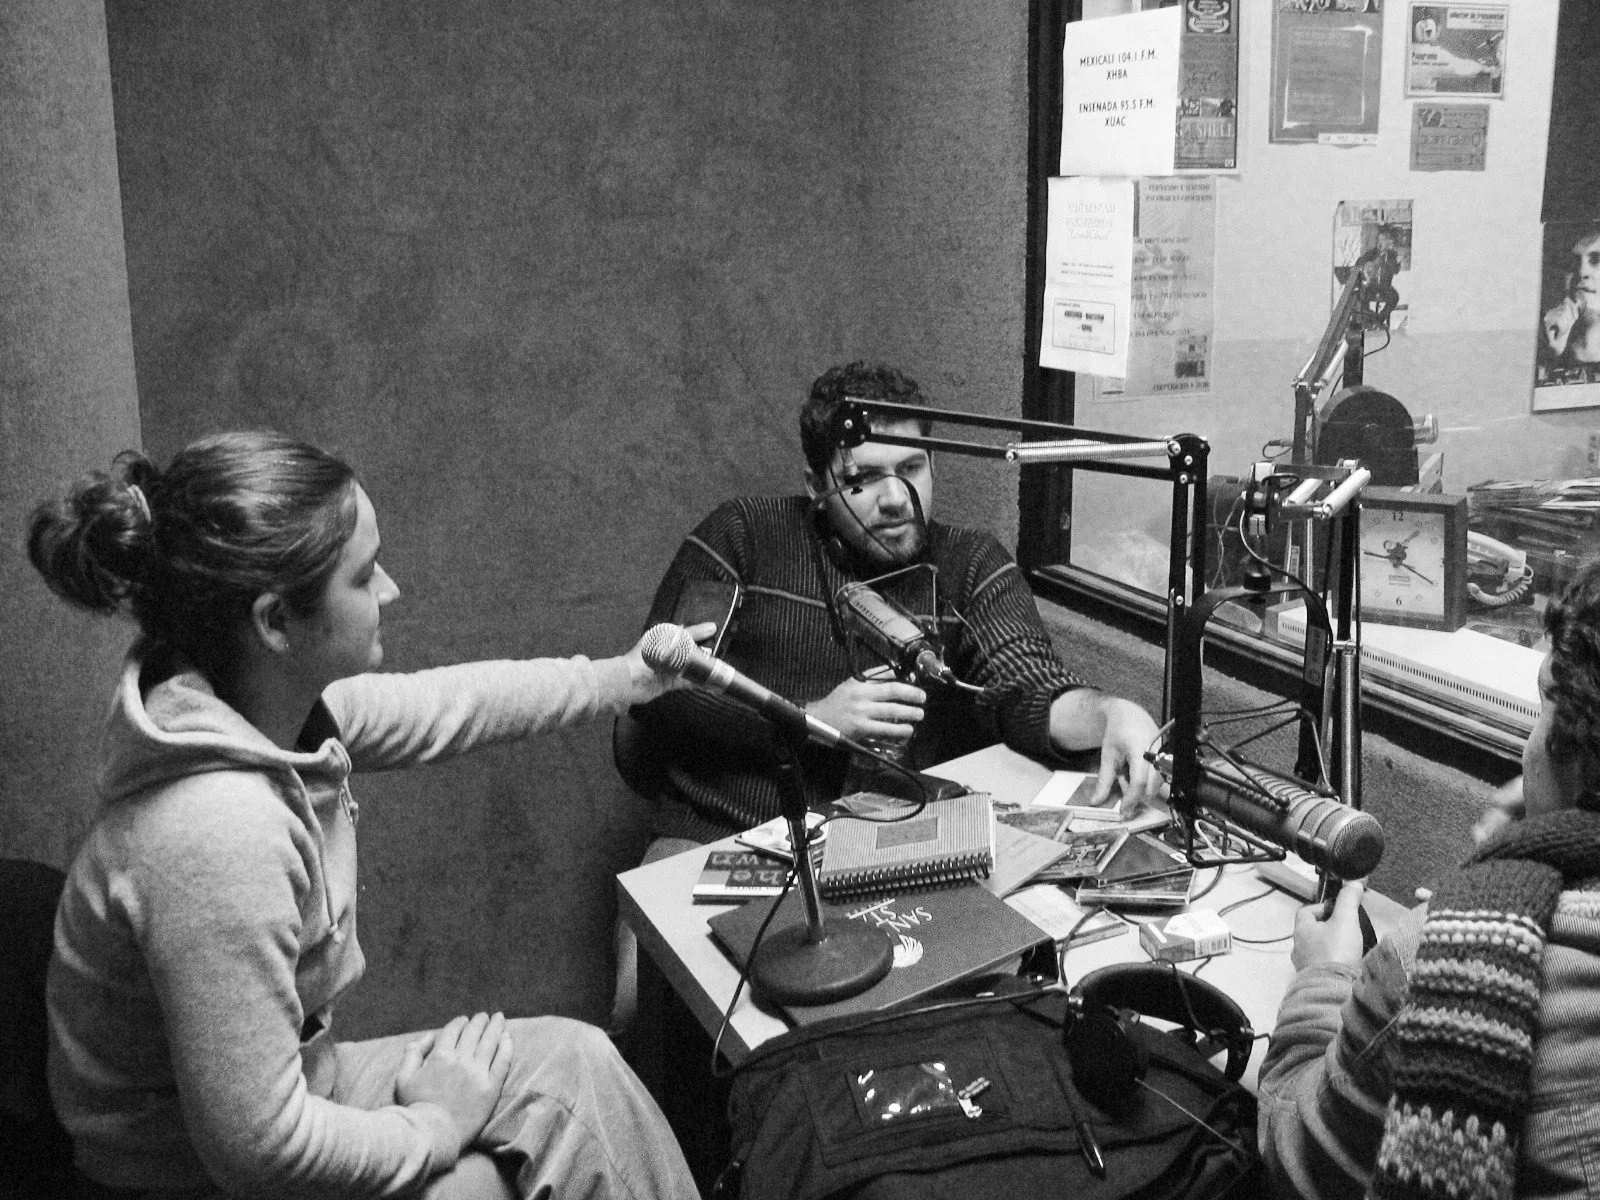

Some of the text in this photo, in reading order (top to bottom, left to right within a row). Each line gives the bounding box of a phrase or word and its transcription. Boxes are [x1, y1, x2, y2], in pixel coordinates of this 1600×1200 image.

[1080, 48, 1157, 67] MEXICALI 104.1 F.M.
[1106, 68, 1128, 80] XHBA
[1079, 97, 1156, 114] ENSENADA 95.5 F.M.
[1104, 115, 1127, 127] XUAC
[1392, 512, 1404, 521] 12
[1396, 596, 1402, 606] 6
